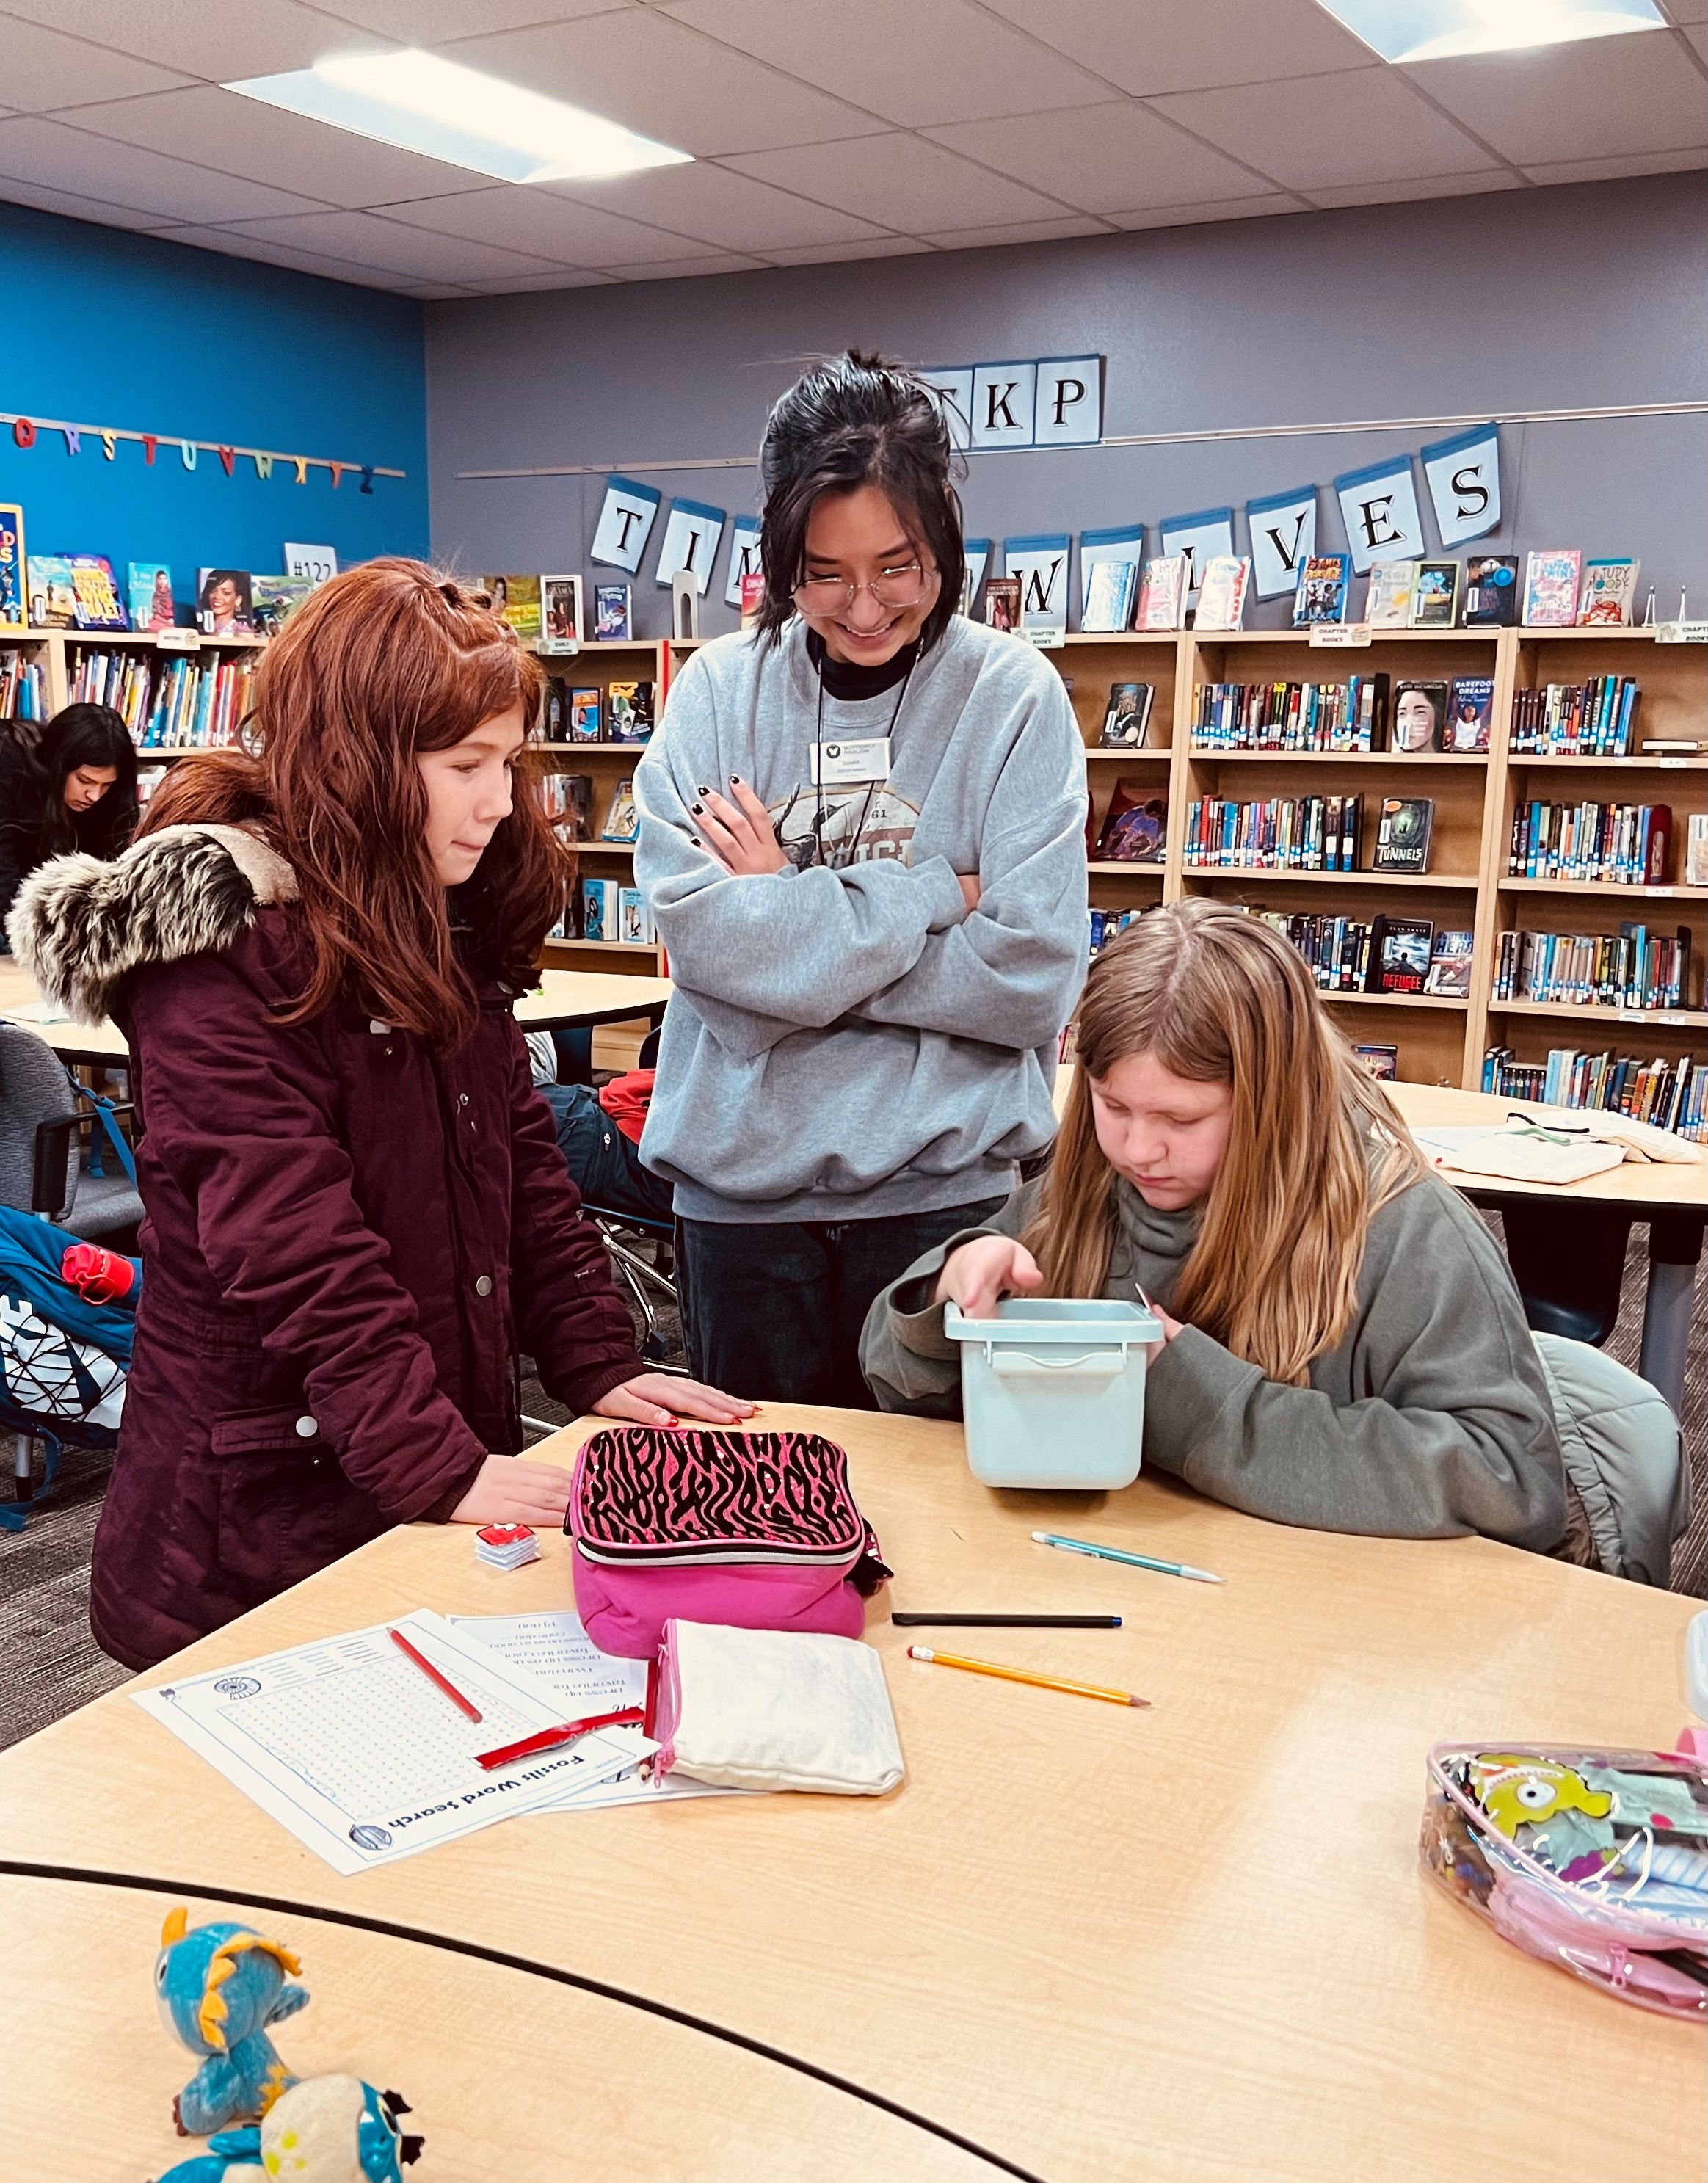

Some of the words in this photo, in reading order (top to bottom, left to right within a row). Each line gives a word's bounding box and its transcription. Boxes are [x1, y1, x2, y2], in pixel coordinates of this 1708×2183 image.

[294, 562, 331, 582] #122
[1601, 566, 1631, 579] JUDY
[1377, 844, 1422, 864] TUNNELS
[1383, 973, 1422, 990] REFUGEE
[522, 1754, 585, 1782] Fossils
[461, 1779, 521, 1805] Word
[387, 1800, 460, 1828] Search
